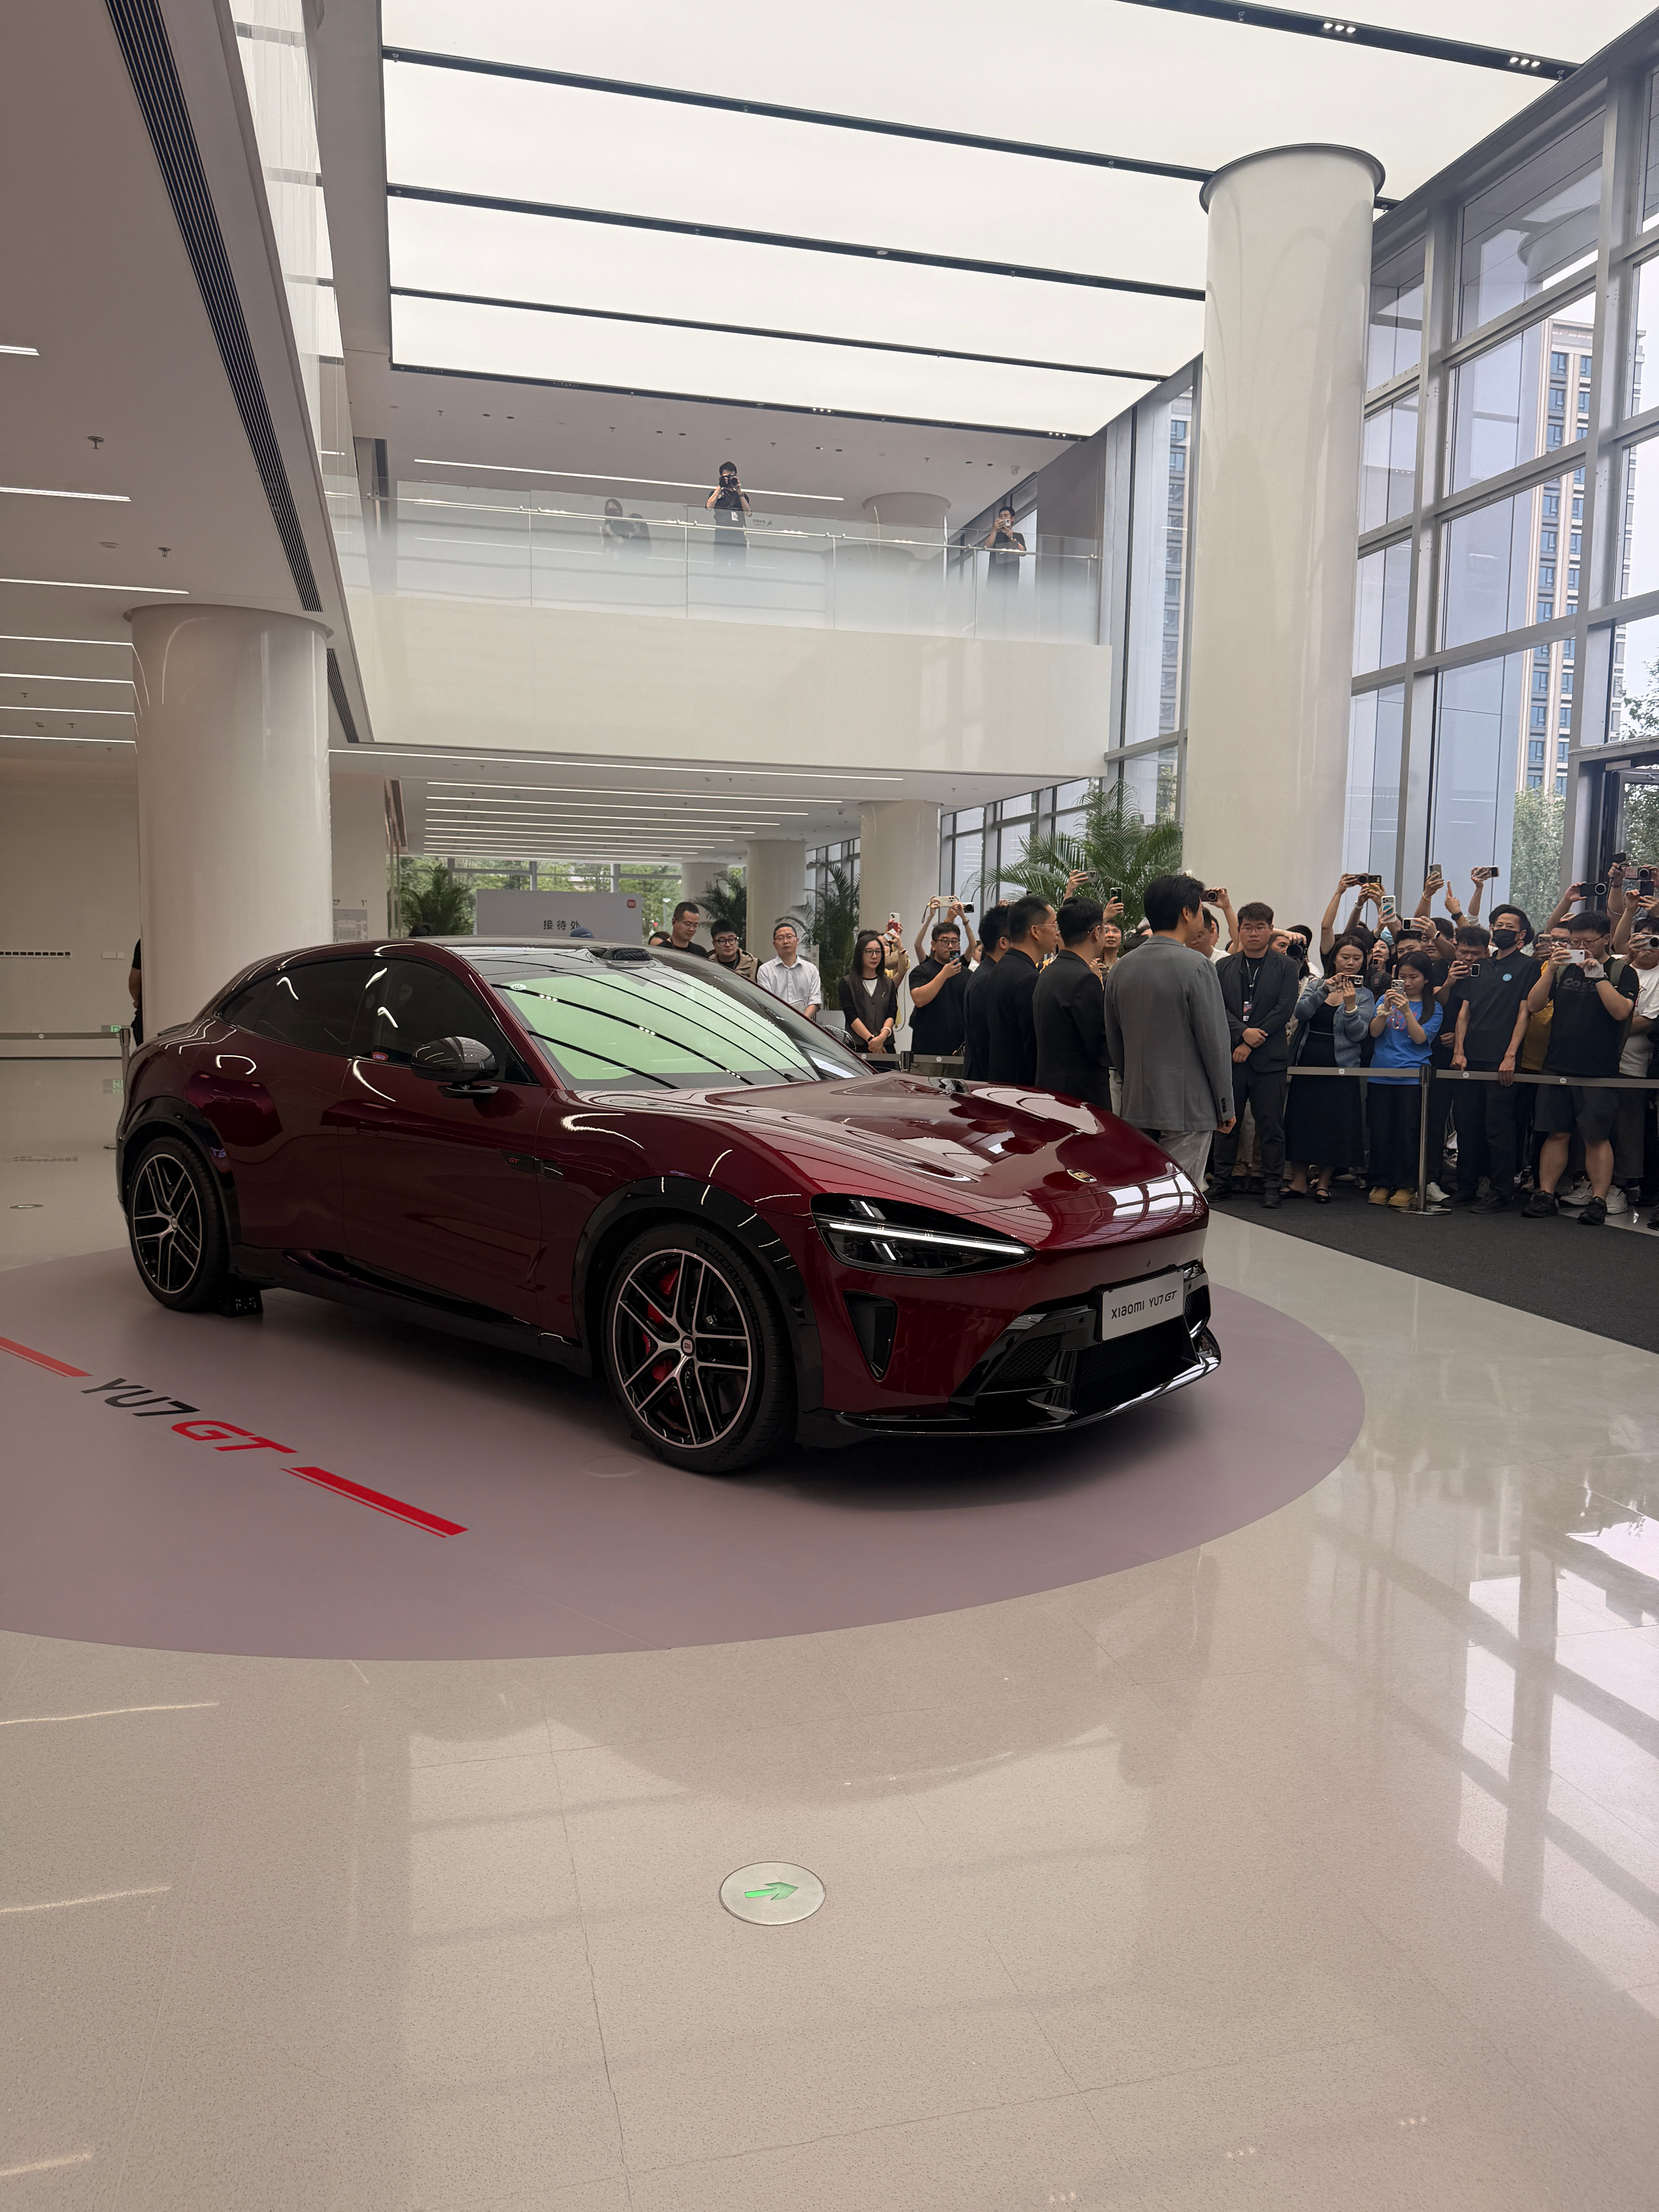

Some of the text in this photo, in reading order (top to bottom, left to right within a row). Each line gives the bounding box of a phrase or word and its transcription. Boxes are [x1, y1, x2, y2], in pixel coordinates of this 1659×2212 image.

[543, 920, 580, 930] 接待处
[707, 1246, 744, 1288] MICHELIN
[1149, 1295, 1163, 1307] YU7
[1165, 1290, 1177, 1302] GT
[81, 1378, 299, 1453] YU7 GT
